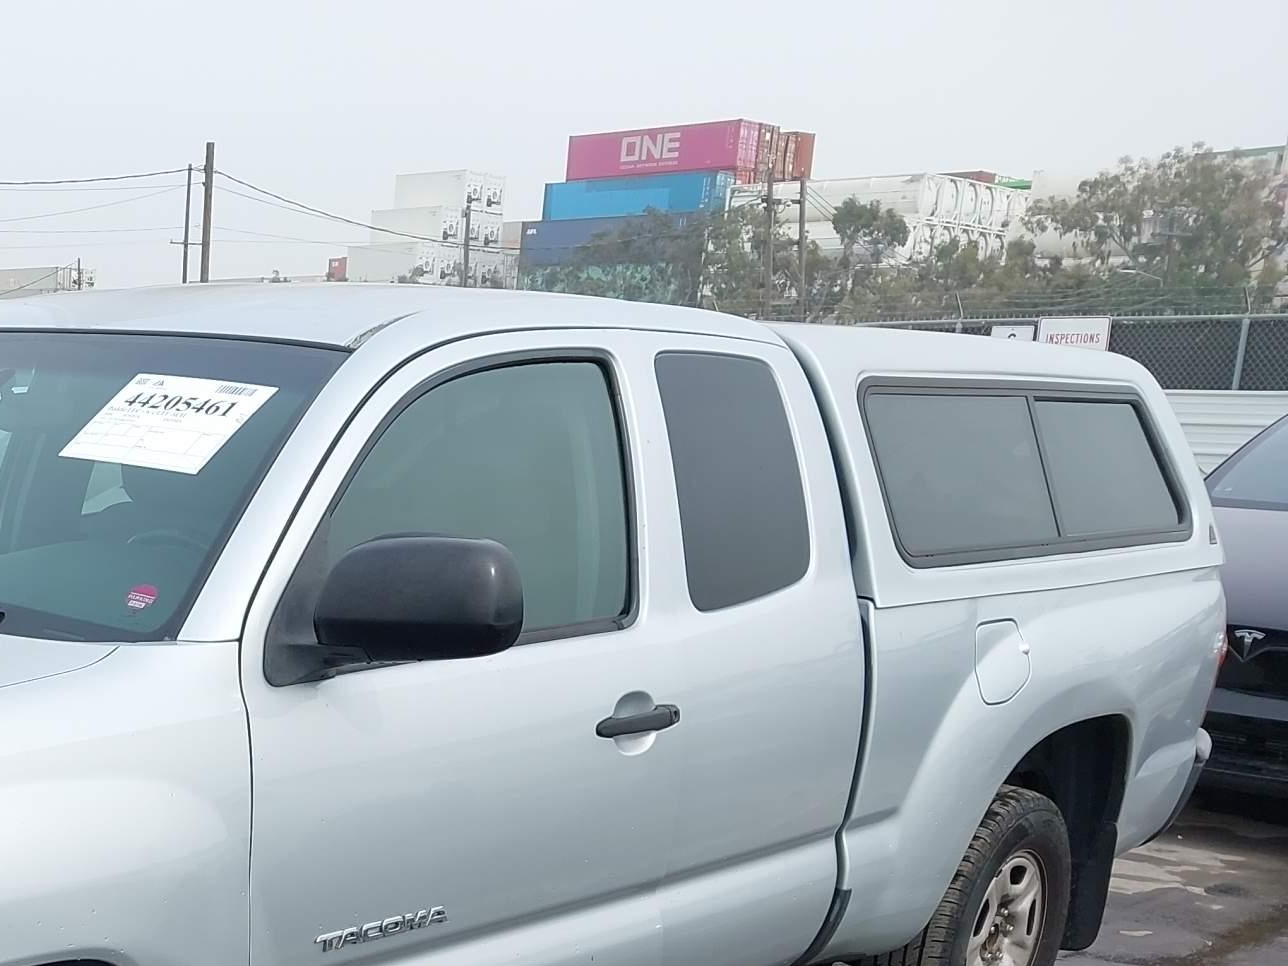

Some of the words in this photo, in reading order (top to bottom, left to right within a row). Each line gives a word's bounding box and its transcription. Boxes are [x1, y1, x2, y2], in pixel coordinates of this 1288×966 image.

[619, 132, 681, 162] ONE
[1045, 332, 1101, 345] INSPECTIONS
[124, 391, 238, 417] 44205461
[313, 905, 449, 953] TACOMA
